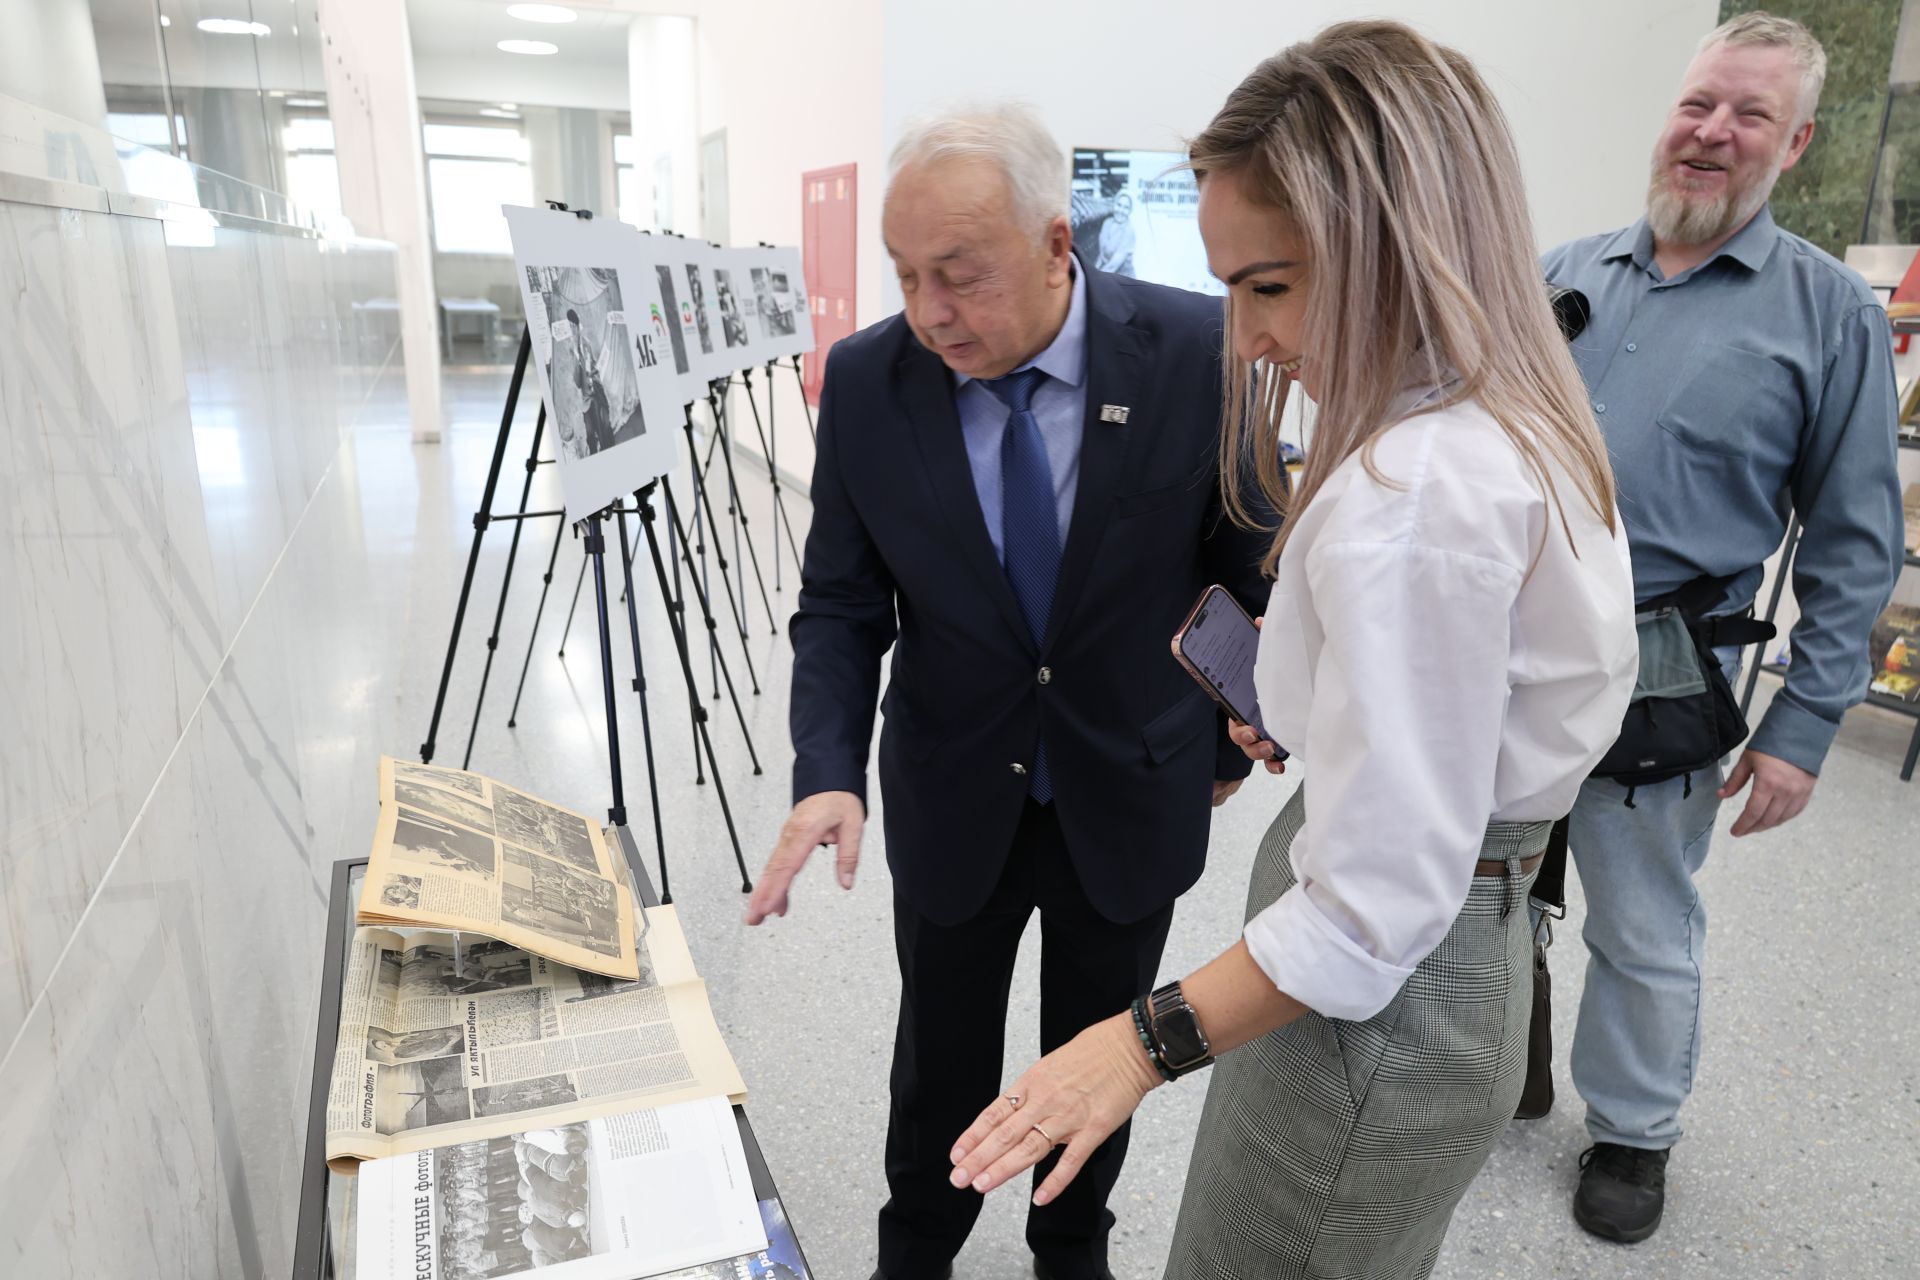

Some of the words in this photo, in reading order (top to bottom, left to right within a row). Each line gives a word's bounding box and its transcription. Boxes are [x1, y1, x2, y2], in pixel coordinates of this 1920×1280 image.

[361, 1073, 375, 1129] Фотография
[414, 1149, 433, 1192] фотогр
[415, 1195, 432, 1280] ЕСКУЧНЫЕ
[758, 1251, 774, 1267] ра
